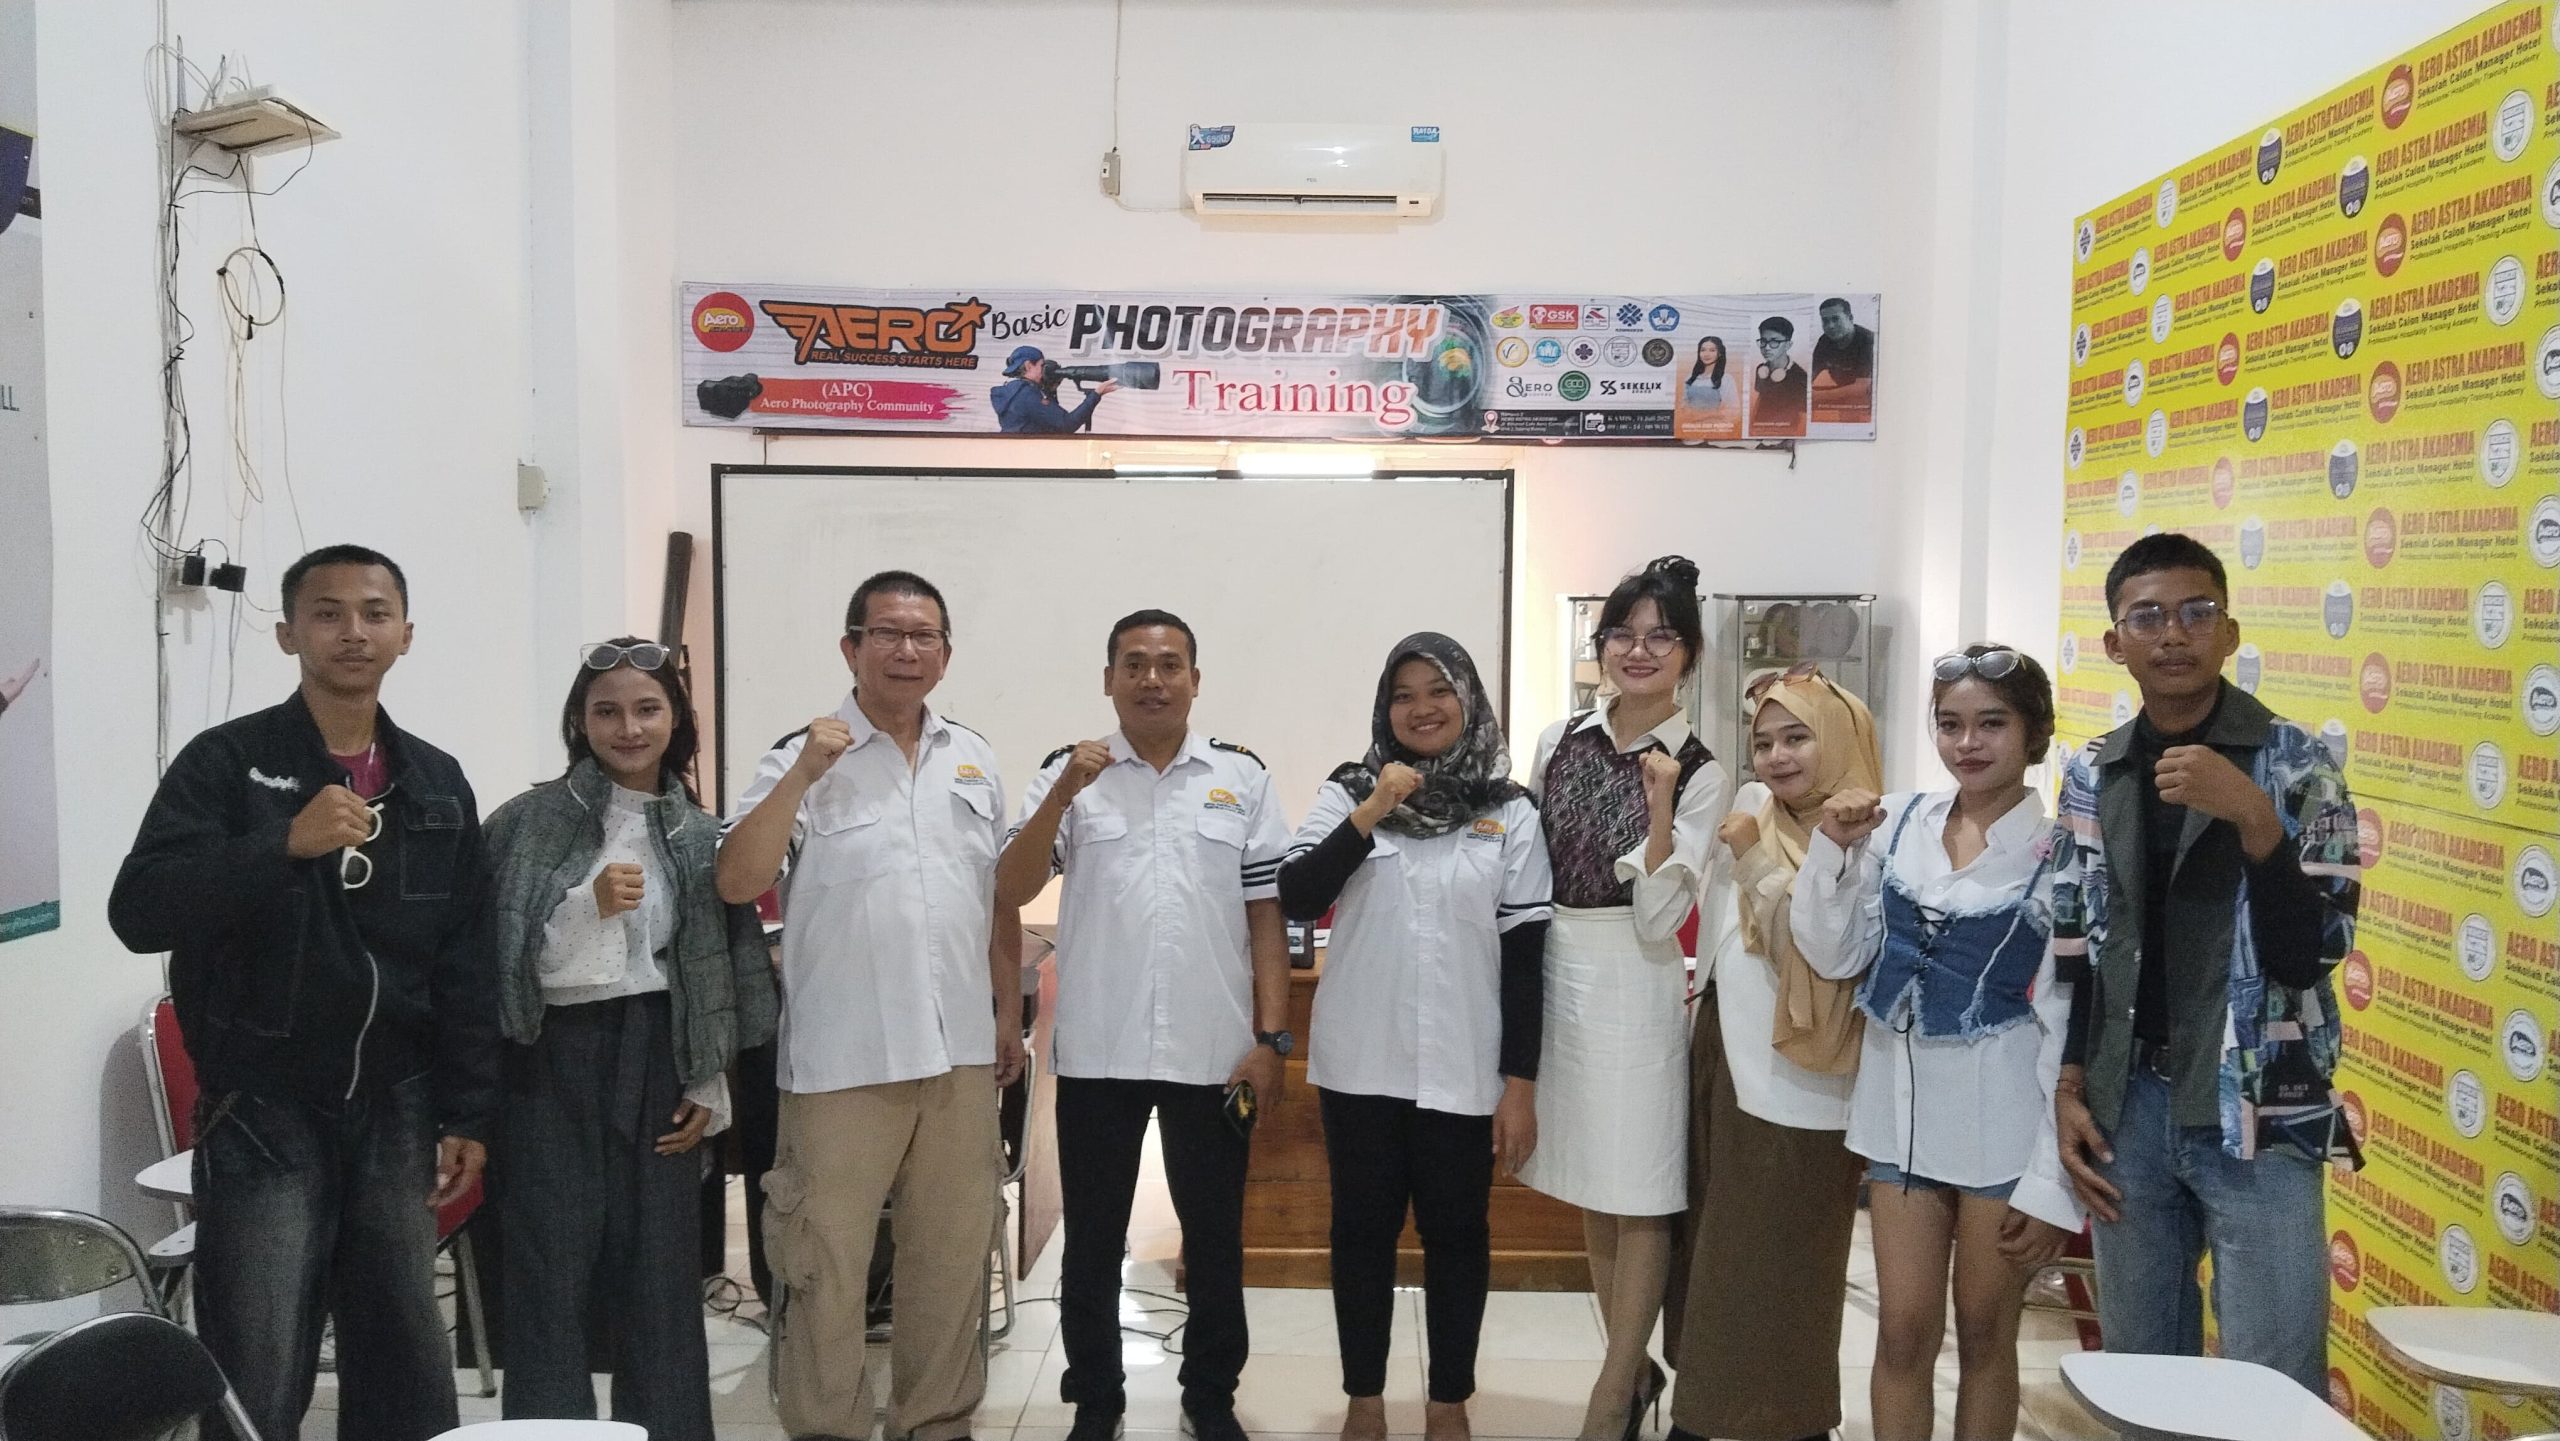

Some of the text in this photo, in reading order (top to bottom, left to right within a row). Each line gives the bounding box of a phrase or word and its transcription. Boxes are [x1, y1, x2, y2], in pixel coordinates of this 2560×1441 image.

[2418, 4, 2541, 84] AERO ASTRA AKADEMIA
[2418, 35, 2540, 99] Sekolah Calon Manager Hotel
[2375, 109, 2488, 176] AERO ASTRA AKADEMIA
[2375, 138, 2487, 190] Sekolah Calon Manager Hotel
[2252, 199, 2270, 224] AERO
[2271, 189, 2295, 217] ASTRA
[2297, 171, 2338, 207] AKADEMIA
[2411, 174, 2532, 236] AERO ASTRA AKADEMIA
[2410, 203, 2531, 250] Sekolah Calon Manager Hotel
[2277, 229, 2369, 278] AERO ASTRA AKADEMIA
[1547, 310, 1575, 320] GSK
[2369, 270, 2480, 321] AERO ASTRA AKADEMIA
[2369, 299, 2480, 334] Sekolah Calon Manager Hotel
[703, 312, 738, 327] Aero
[762, 303, 976, 356] AERO
[991, 303, 1440, 354] Basic PHOTOGRAPHY
[811, 351, 976, 369] REAL SUCCESS STARTS HERE
[2405, 341, 2525, 386] AERO ASTRA AKADEMIA
[760, 398, 934, 414] Aero Photography Community
[822, 382, 872, 398] (APC)
[1172, 369, 1412, 426] Training
[1620, 382, 1662, 390] SEKELIX
[2405, 370, 2524, 400] Sekolah Calon Manager Hotel
[2365, 430, 2475, 465] AERO ASTRA AKADEMIA
[2400, 506, 2519, 534] AERO ASTRA AKADEMIA
[2360, 587, 2470, 611] AERO ASTRA AKADEMIA
[2395, 661, 2513, 693] AERO ASTRA AKADEMIA
[2355, 729, 2464, 768] AERO ASTRA AKADEMIA
[2387, 819, 2505, 870] AERO ASTRA AKADEMIA
[2378, 965, 2494, 1030] AERO ASTRA AKADEMIA
[2371, 1109, 2485, 1189] AERO ASTRA AKADEMIA
